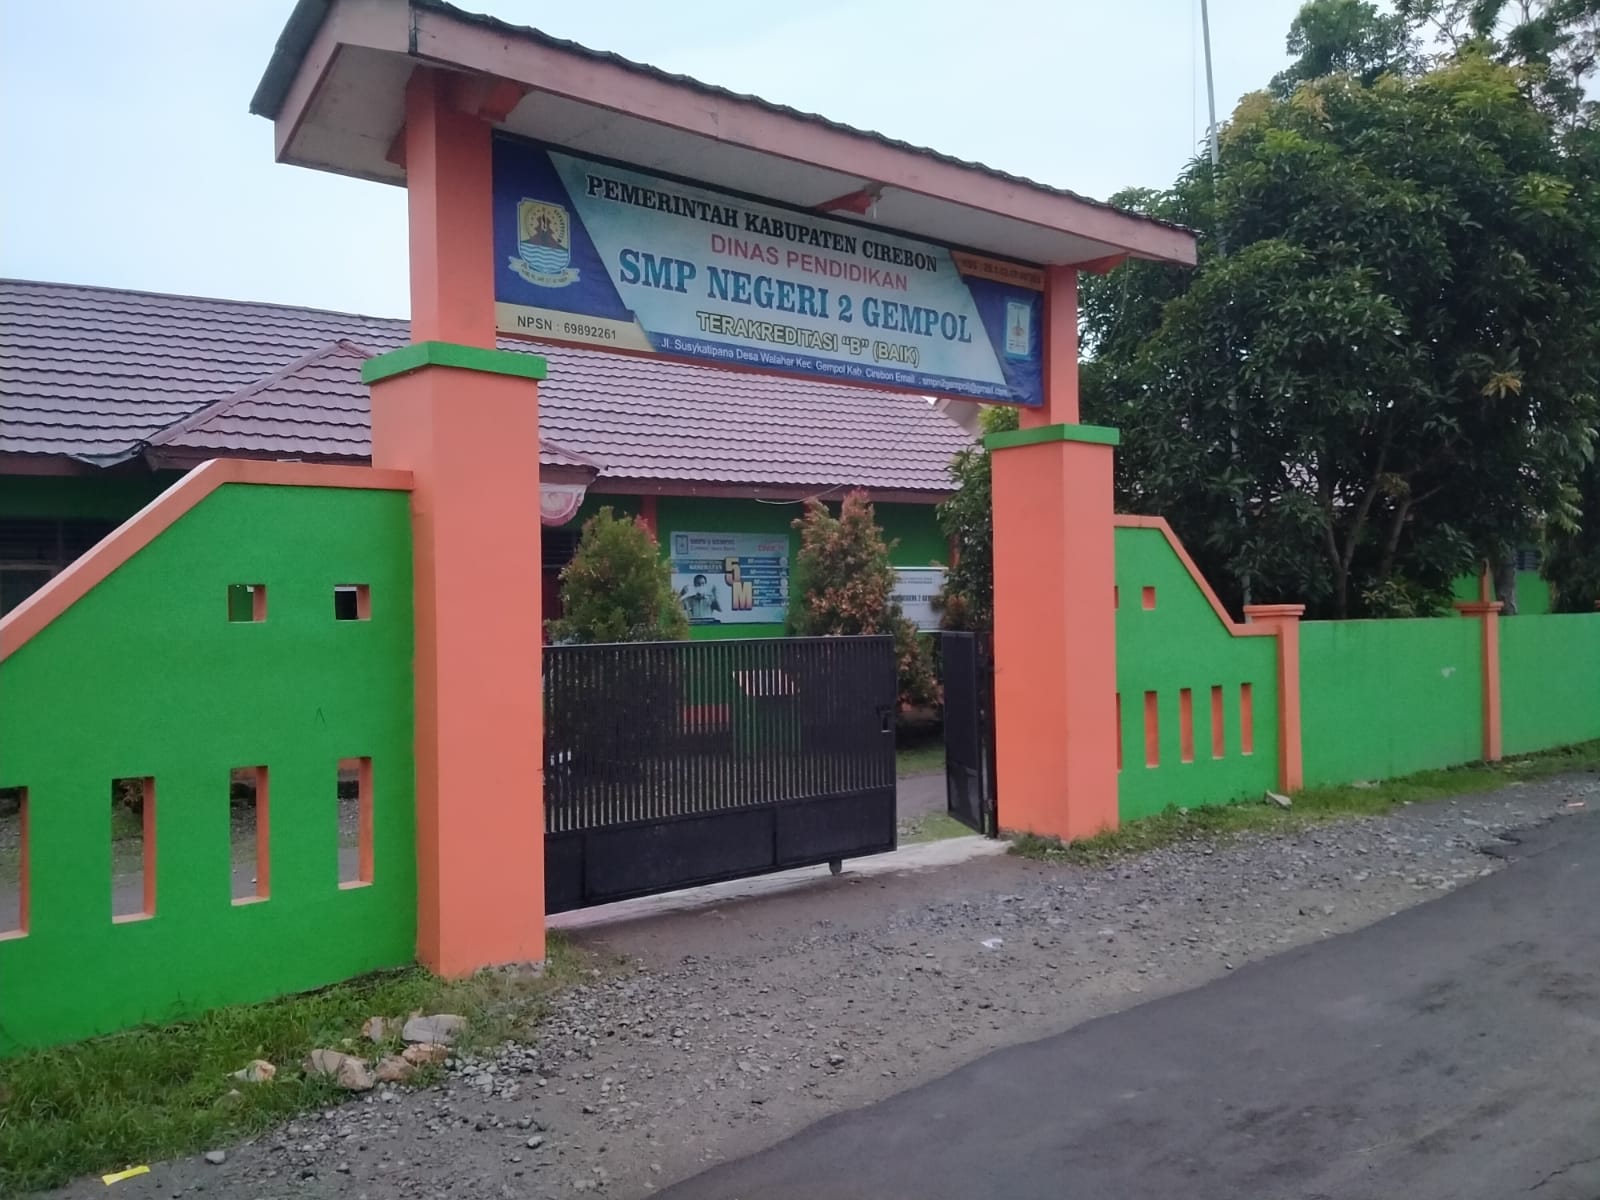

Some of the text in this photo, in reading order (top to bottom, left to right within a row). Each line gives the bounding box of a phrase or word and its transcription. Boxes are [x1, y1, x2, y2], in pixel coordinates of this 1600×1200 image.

[586, 174, 738, 229] PEMERINTAH
[744, 212, 858, 256] KABUPATEN
[862, 240, 938, 273] CIREBON
[710, 234, 909, 292] DINAS PENDIDIKAN
[618, 248, 973, 344] SMP NEGERI 2 GEMPOL
[516, 315, 553, 332] NPSN
[563, 321, 617, 341] 69892261
[696, 311, 838, 353] TERAKREDITASI
[872, 341, 920, 368] (BAIK)
[735, 349, 759, 362] Desa
[759, 352, 794, 366] Walahar
[815, 361, 847, 376] Gempol
[865, 368, 895, 382] Cirebon
[895, 372, 916, 384] Email
[724, 557, 741, 587] 5
[731, 581, 753, 611] M
